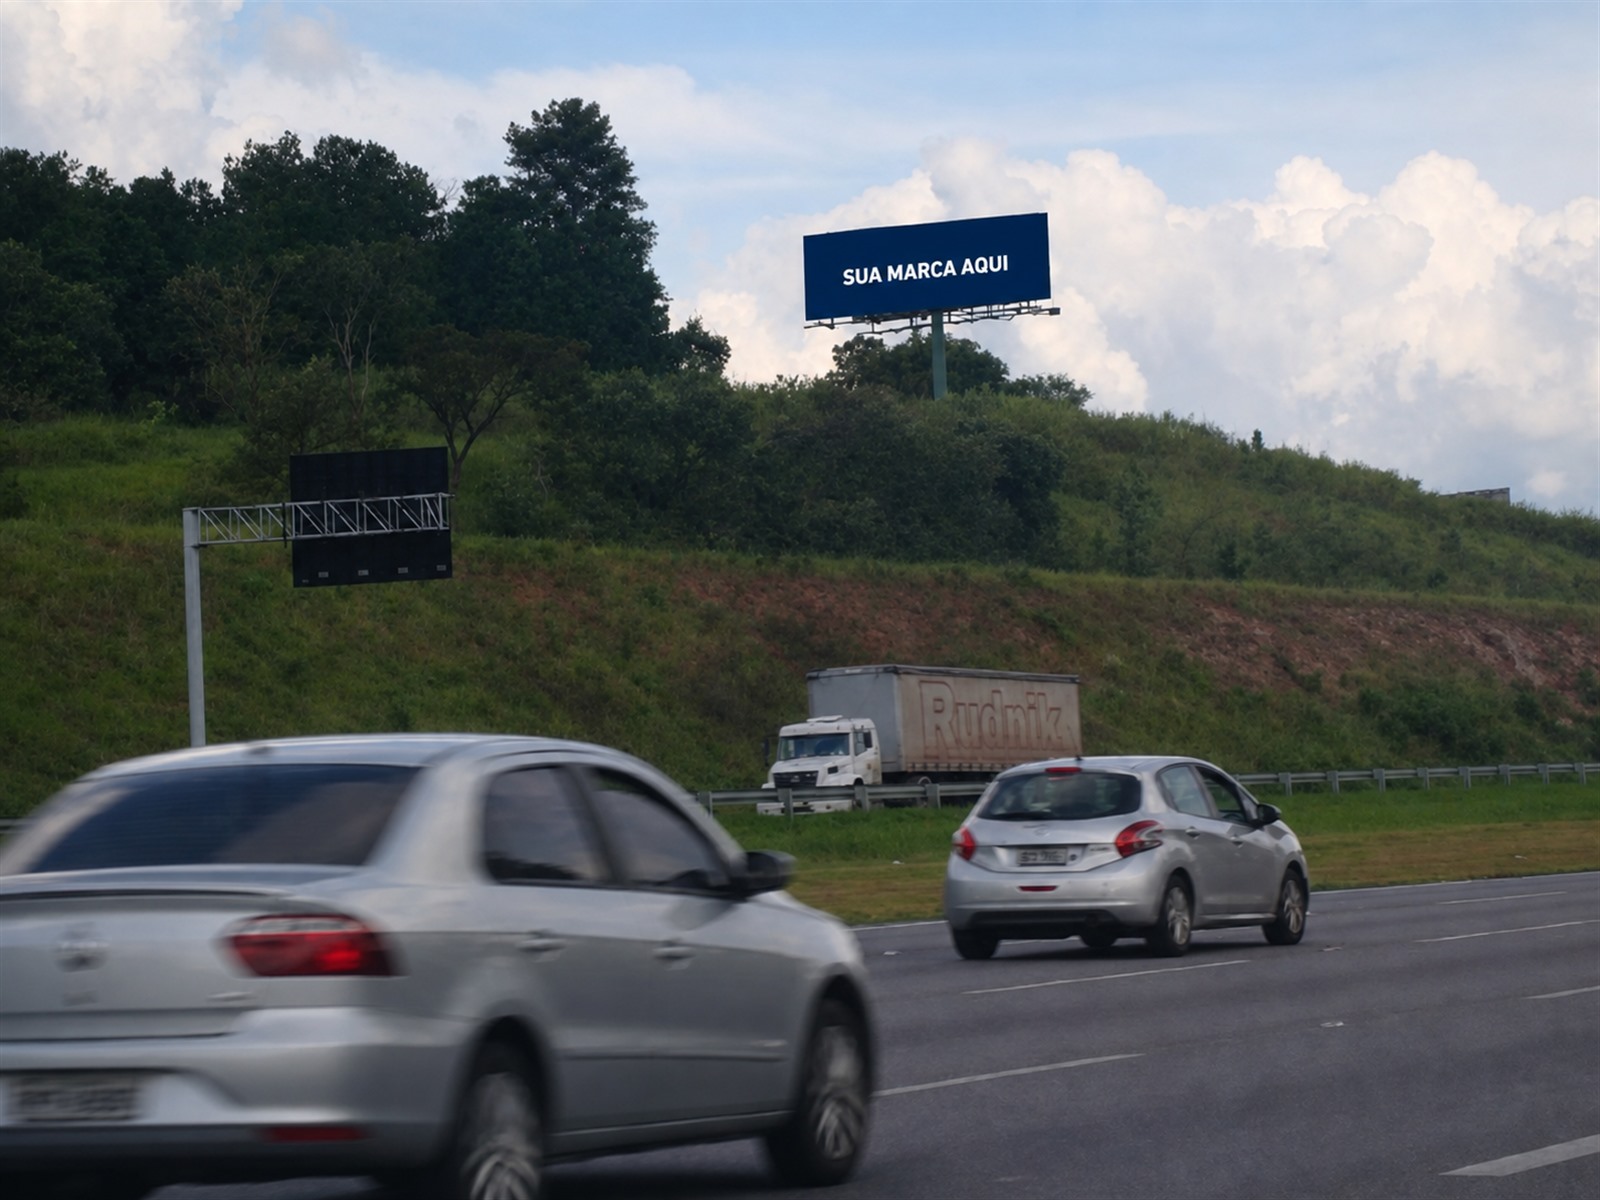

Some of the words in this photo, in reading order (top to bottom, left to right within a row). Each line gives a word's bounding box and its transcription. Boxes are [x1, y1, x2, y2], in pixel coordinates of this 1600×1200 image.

[843, 267, 882, 286] SUA
[887, 260, 957, 282] MARCA
[961, 254, 1009, 275] AQUI
[919, 680, 1077, 756] Rudnik
